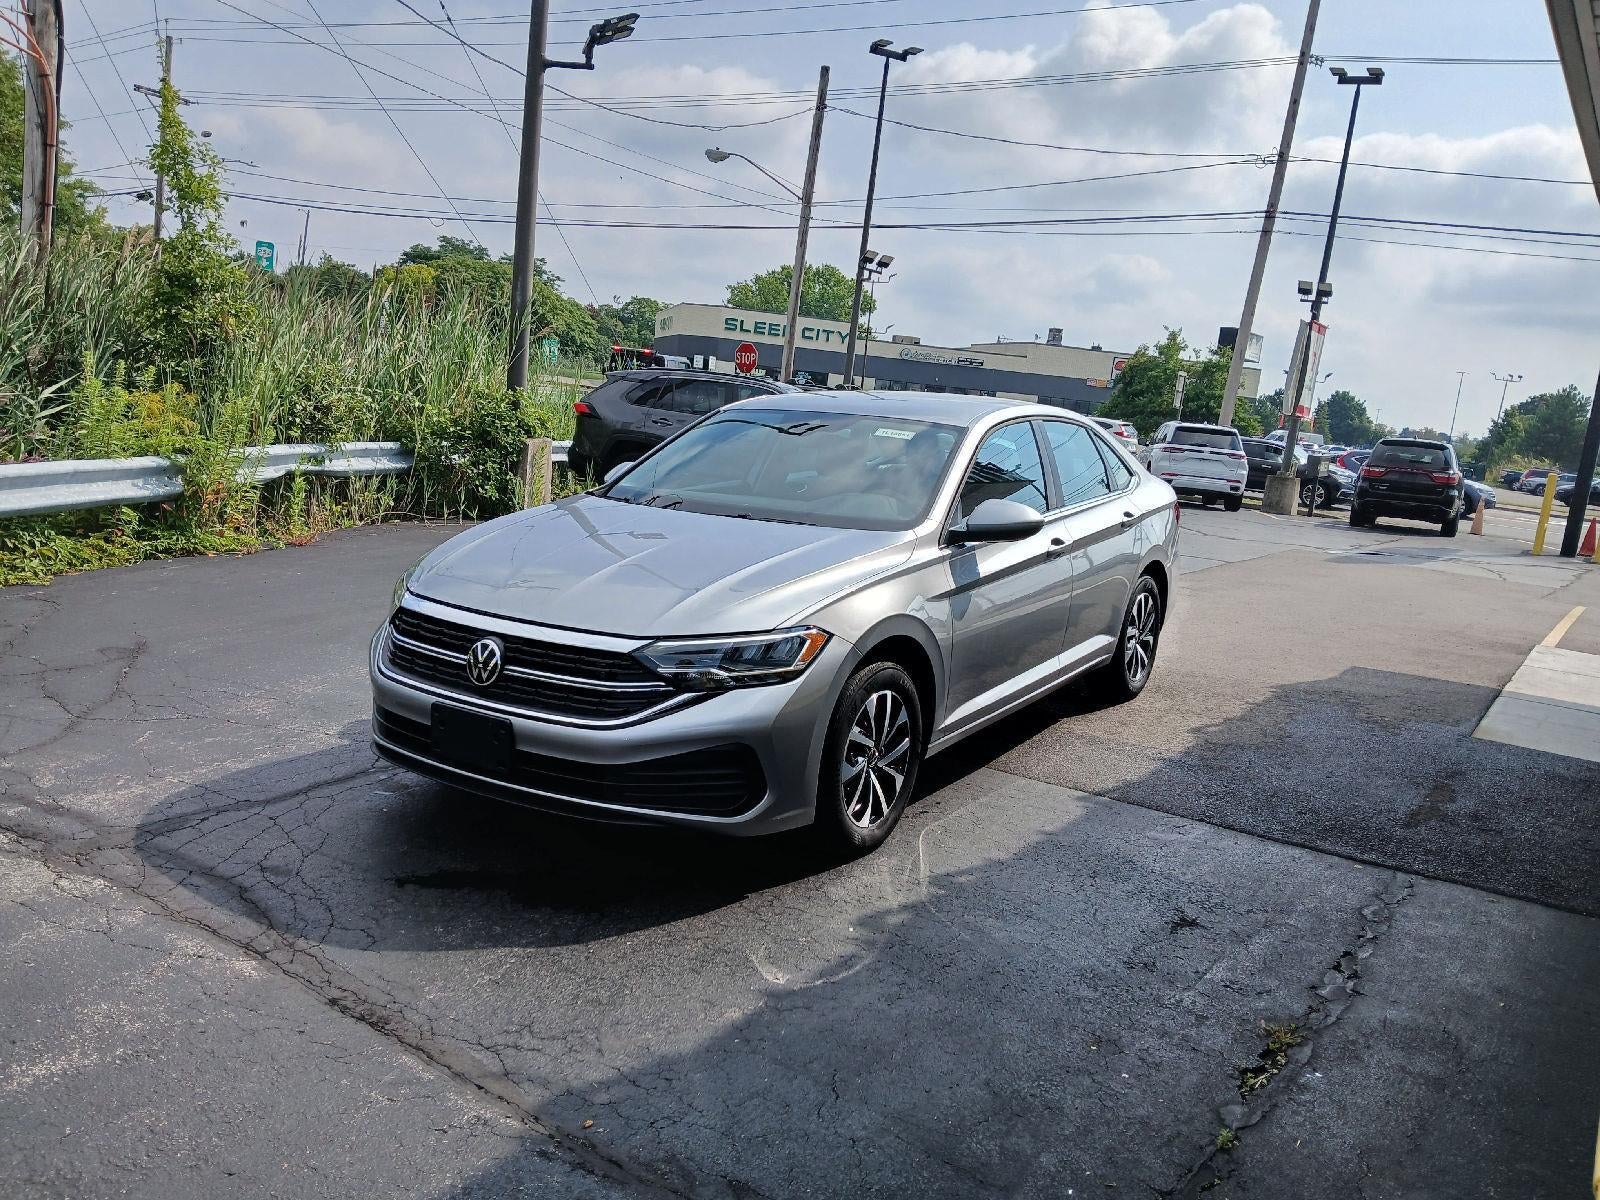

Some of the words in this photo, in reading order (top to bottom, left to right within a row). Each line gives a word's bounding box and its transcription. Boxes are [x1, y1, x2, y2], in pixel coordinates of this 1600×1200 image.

[724, 317, 787, 338] SLEE
[801, 326, 850, 344] CITY
[736, 352, 756, 365] STOP
